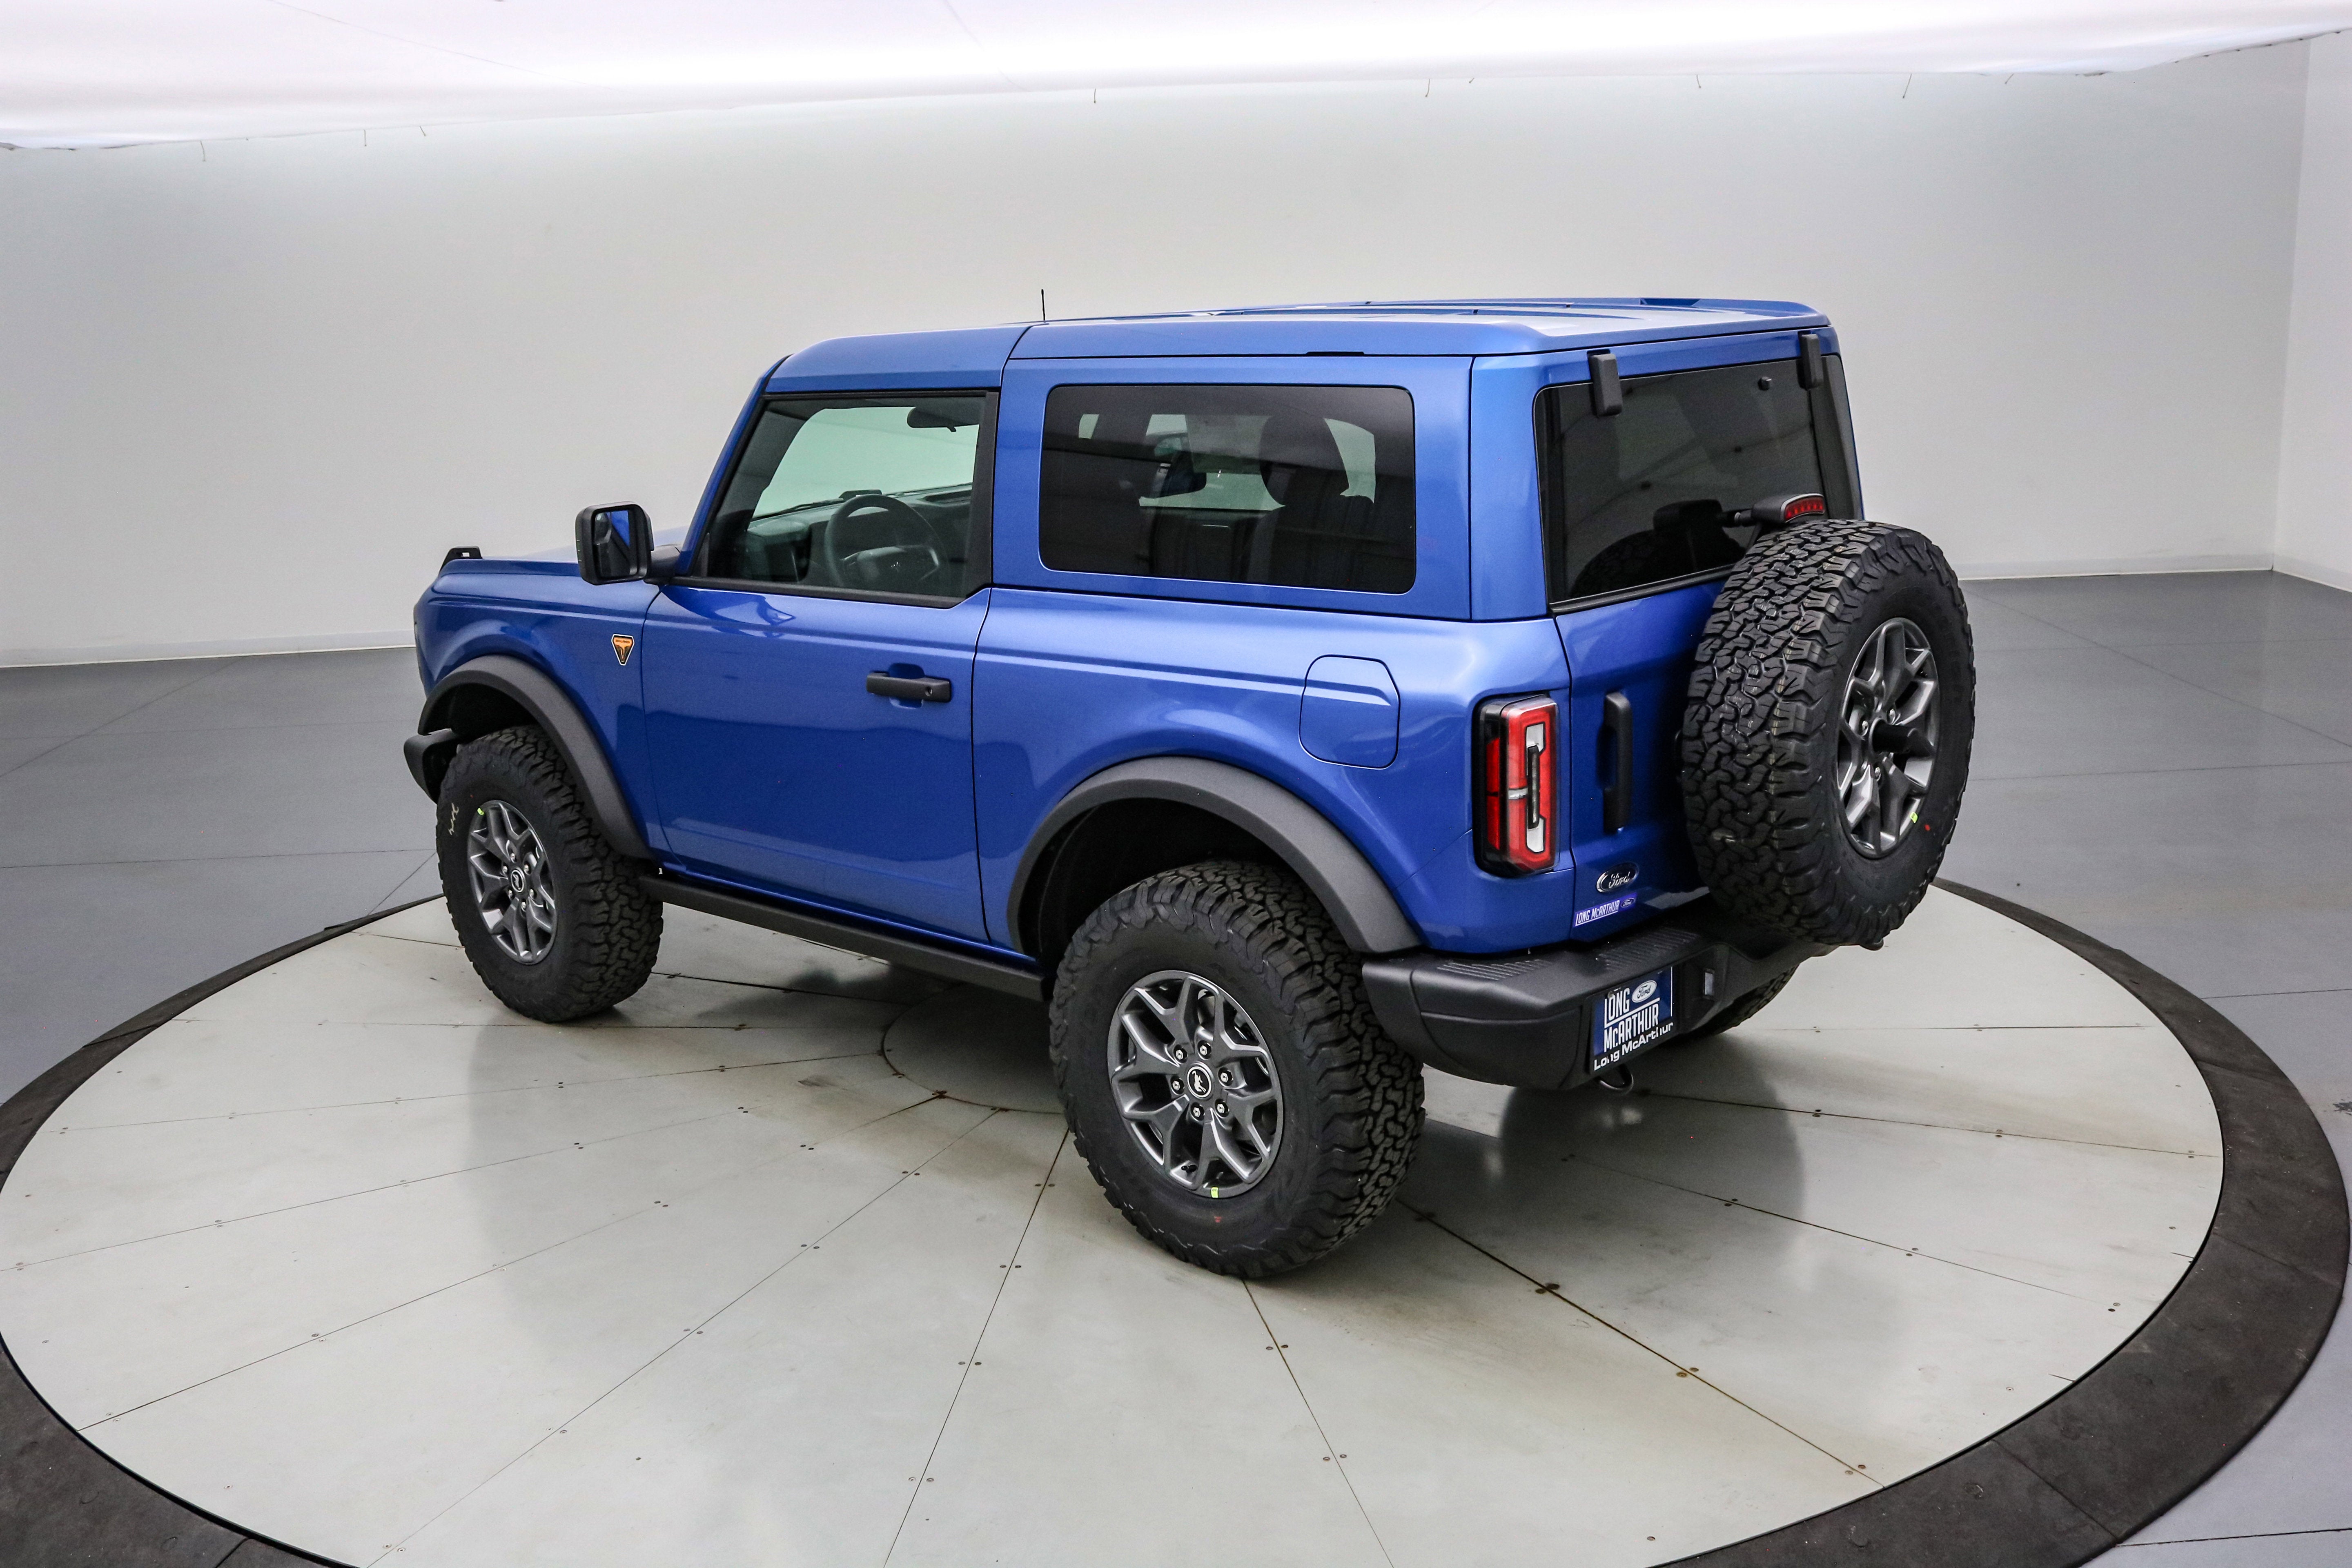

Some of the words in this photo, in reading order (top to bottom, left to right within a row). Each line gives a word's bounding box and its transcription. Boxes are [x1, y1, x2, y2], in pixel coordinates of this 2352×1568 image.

[1575, 909, 1591, 927] LONG
[1604, 987, 1630, 1029] LONG
[1594, 1050, 1620, 1071] Long
[1622, 1022, 1674, 1056] McArthur
